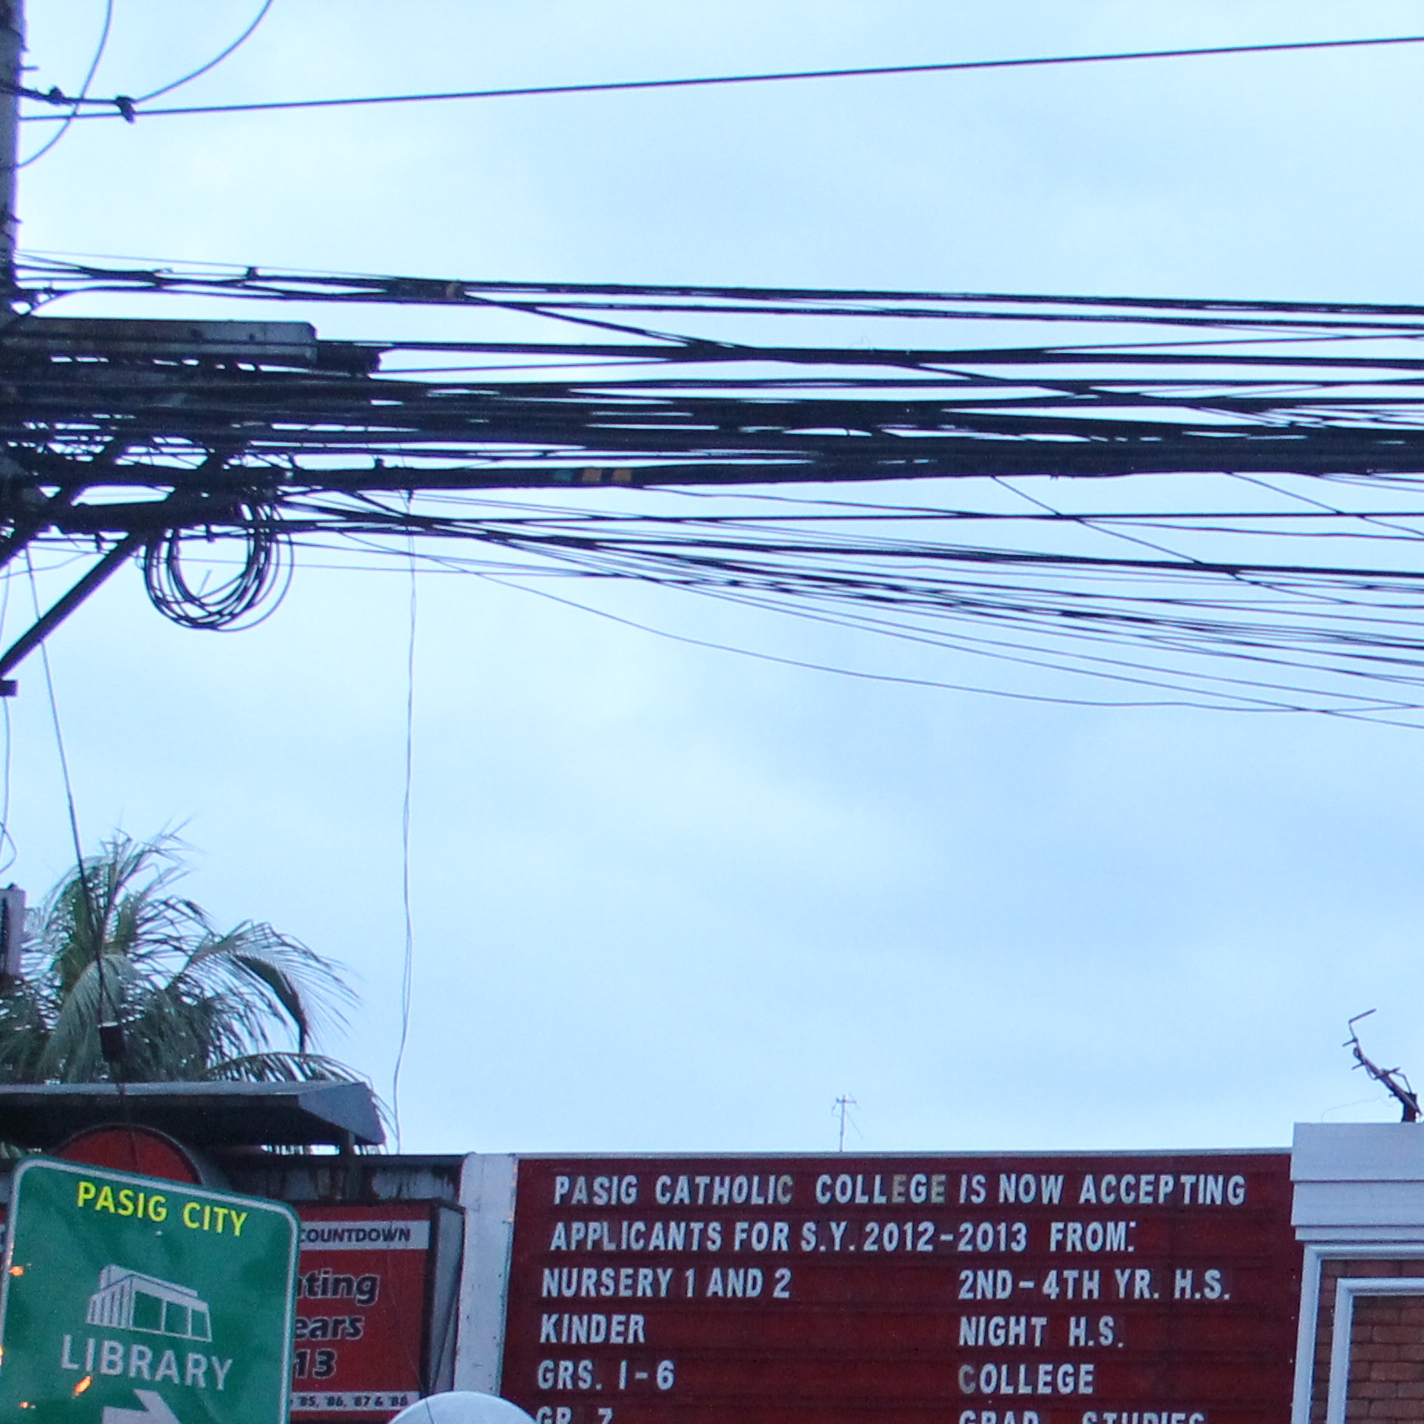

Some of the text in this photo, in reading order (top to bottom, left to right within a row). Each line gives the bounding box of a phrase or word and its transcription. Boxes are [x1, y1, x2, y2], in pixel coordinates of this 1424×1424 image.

[554, 1174, 1246, 1205] PASIG CATHOLIC COLLEGE IS NOW ACCEPTING
[77, 1181, 248, 1236] PASIG CITY
[300, 1228, 411, 1243] COUNTDOWN
[550, 1221, 1136, 1252] APPLICANTS FOR S.Y. 2012-2013 FROM:
[542, 1267, 793, 1299] NURSERY 1 AND 2
[1115, 1269, 1160, 1300] YR.
[1174, 1269, 1231, 1300] H.S.
[540, 1314, 646, 1344] KINDER
[959, 1316, 1124, 1348] NIGHT H.S.
[61, 1334, 234, 1391] LIBRARY
[537, 1360, 602, 1390] GRS.
[958, 1363, 1095, 1394] COLLEGE
